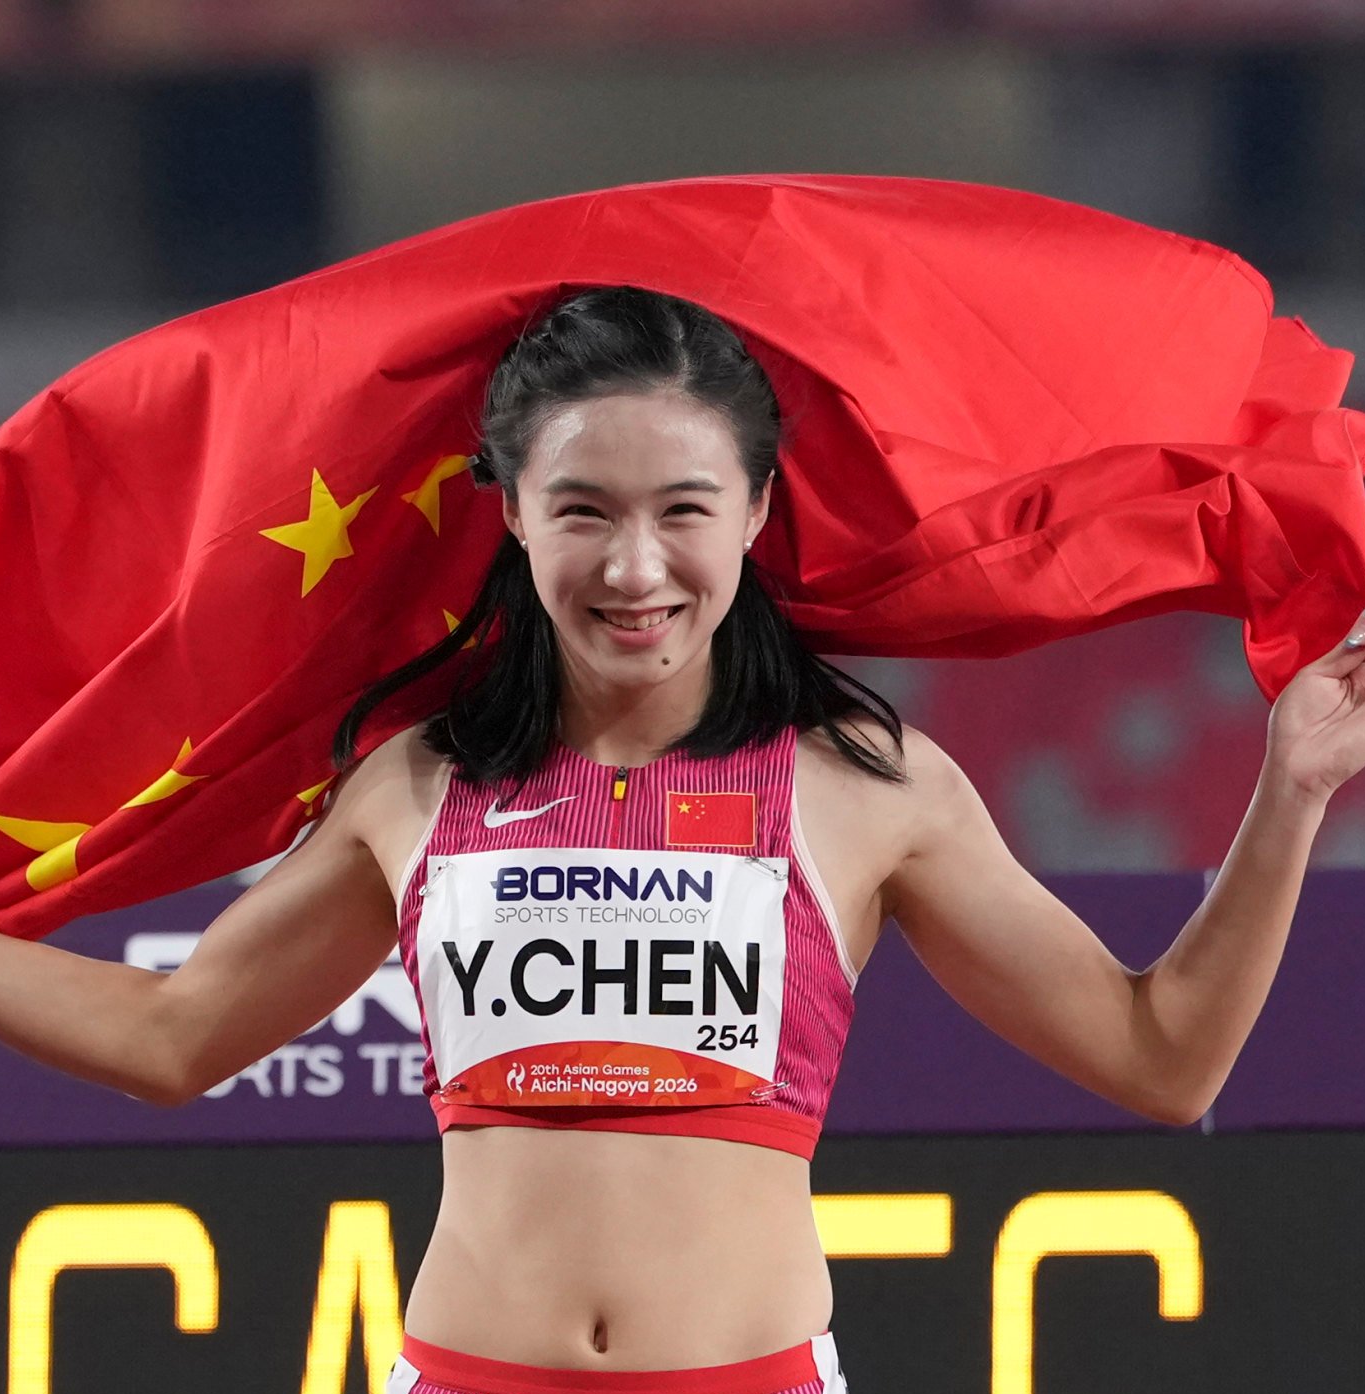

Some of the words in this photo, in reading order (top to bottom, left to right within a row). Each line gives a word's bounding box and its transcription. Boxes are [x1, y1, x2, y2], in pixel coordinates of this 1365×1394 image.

[490, 866, 713, 903] BORNAN
[494, 906, 569, 924] SPORTS
[576, 907, 711, 924] TECHNOLOGY
[441, 938, 760, 1017] Y.CHEN
[696, 1024, 759, 1051] 254
[530, 1064, 559, 1076] 20th
[563, 1064, 599, 1076] Asian
[602, 1064, 650, 1076] Games
[531, 1077, 649, 1097] Aichi-Nagoya
[653, 1078, 698, 1093] 2026
